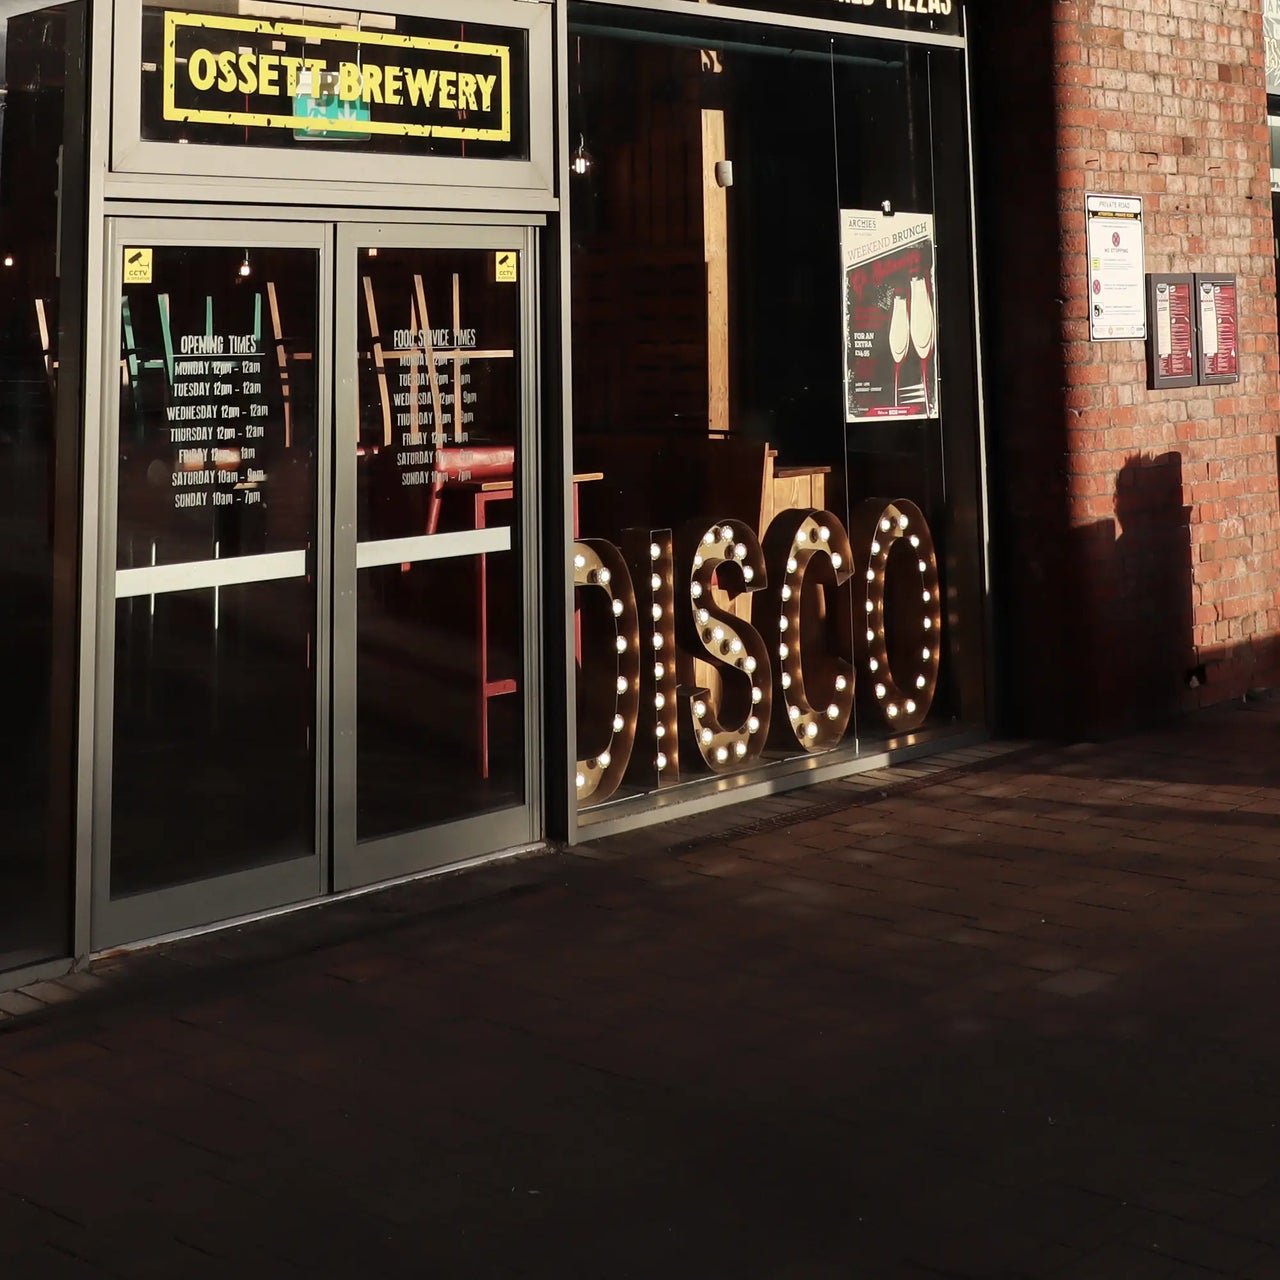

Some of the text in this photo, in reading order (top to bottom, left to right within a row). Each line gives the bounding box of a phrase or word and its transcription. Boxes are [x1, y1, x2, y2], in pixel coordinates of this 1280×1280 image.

[188, 48, 497, 112] OSSETT BREWERY
[848, 222, 927, 261] WEEKEND BRUNCH
[180, 334, 257, 354] OPENING TIMES
[174, 361, 210, 376] MONDAY
[242, 361, 261, 374] 12am
[174, 381, 261, 397] TUESDAY 12pm 12am
[166, 403, 269, 421] WEDNESDAY 12pm 12am
[170, 425, 264, 442] THURSDAY 12pm 12am
[240, 446, 256, 460] 1am
[397, 450, 434, 466] SATURDAY
[172, 470, 216, 487] SATURDAY
[217, 470, 238, 484] 10am
[401, 470, 429, 486] SUNDAY
[175, 490, 261, 508] SUNDAY 10am 7pm
[573, 498, 941, 810] DISCO
